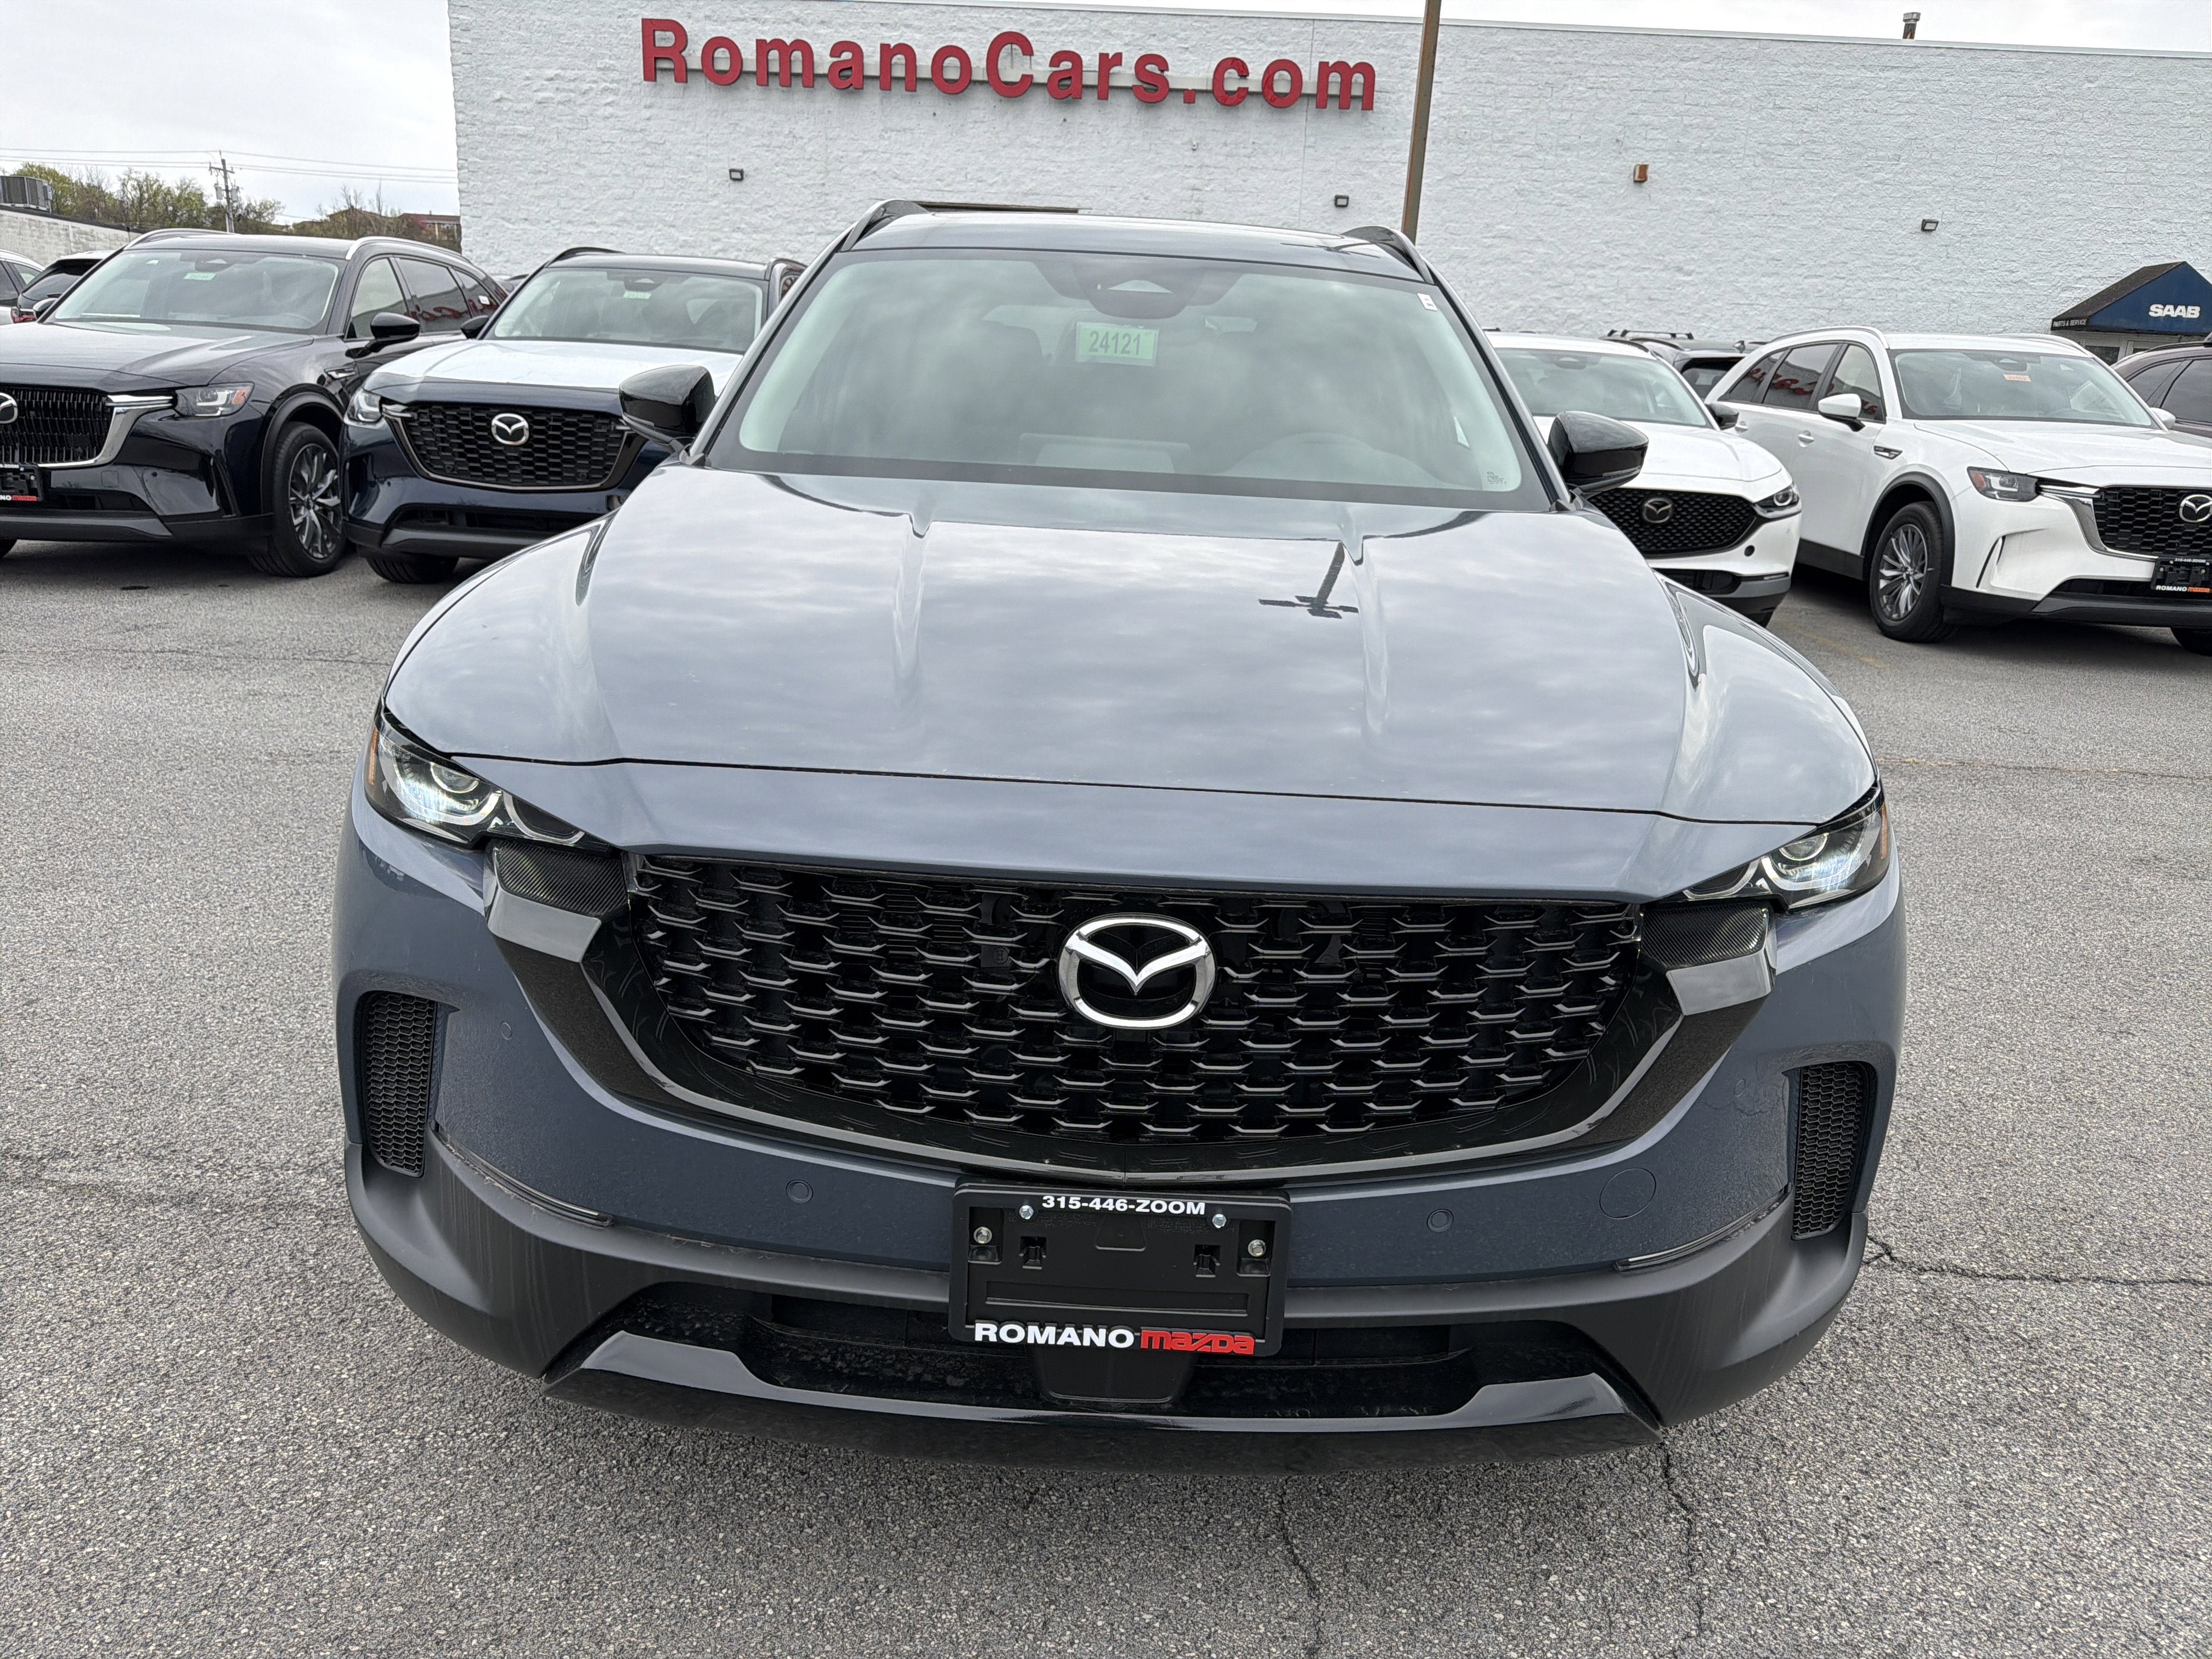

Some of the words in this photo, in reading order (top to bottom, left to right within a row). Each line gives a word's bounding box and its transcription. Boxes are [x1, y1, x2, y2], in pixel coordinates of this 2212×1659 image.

[641, 18, 1375, 111] RomanoCars.com
[2148, 304, 2200, 318] SAAB
[1088, 331, 1141, 356] 24121
[1042, 1195, 1205, 1215] 315-446-ZOOM
[974, 1323, 1135, 1348] ROMANO
[1140, 1330, 1255, 1356] mazda
